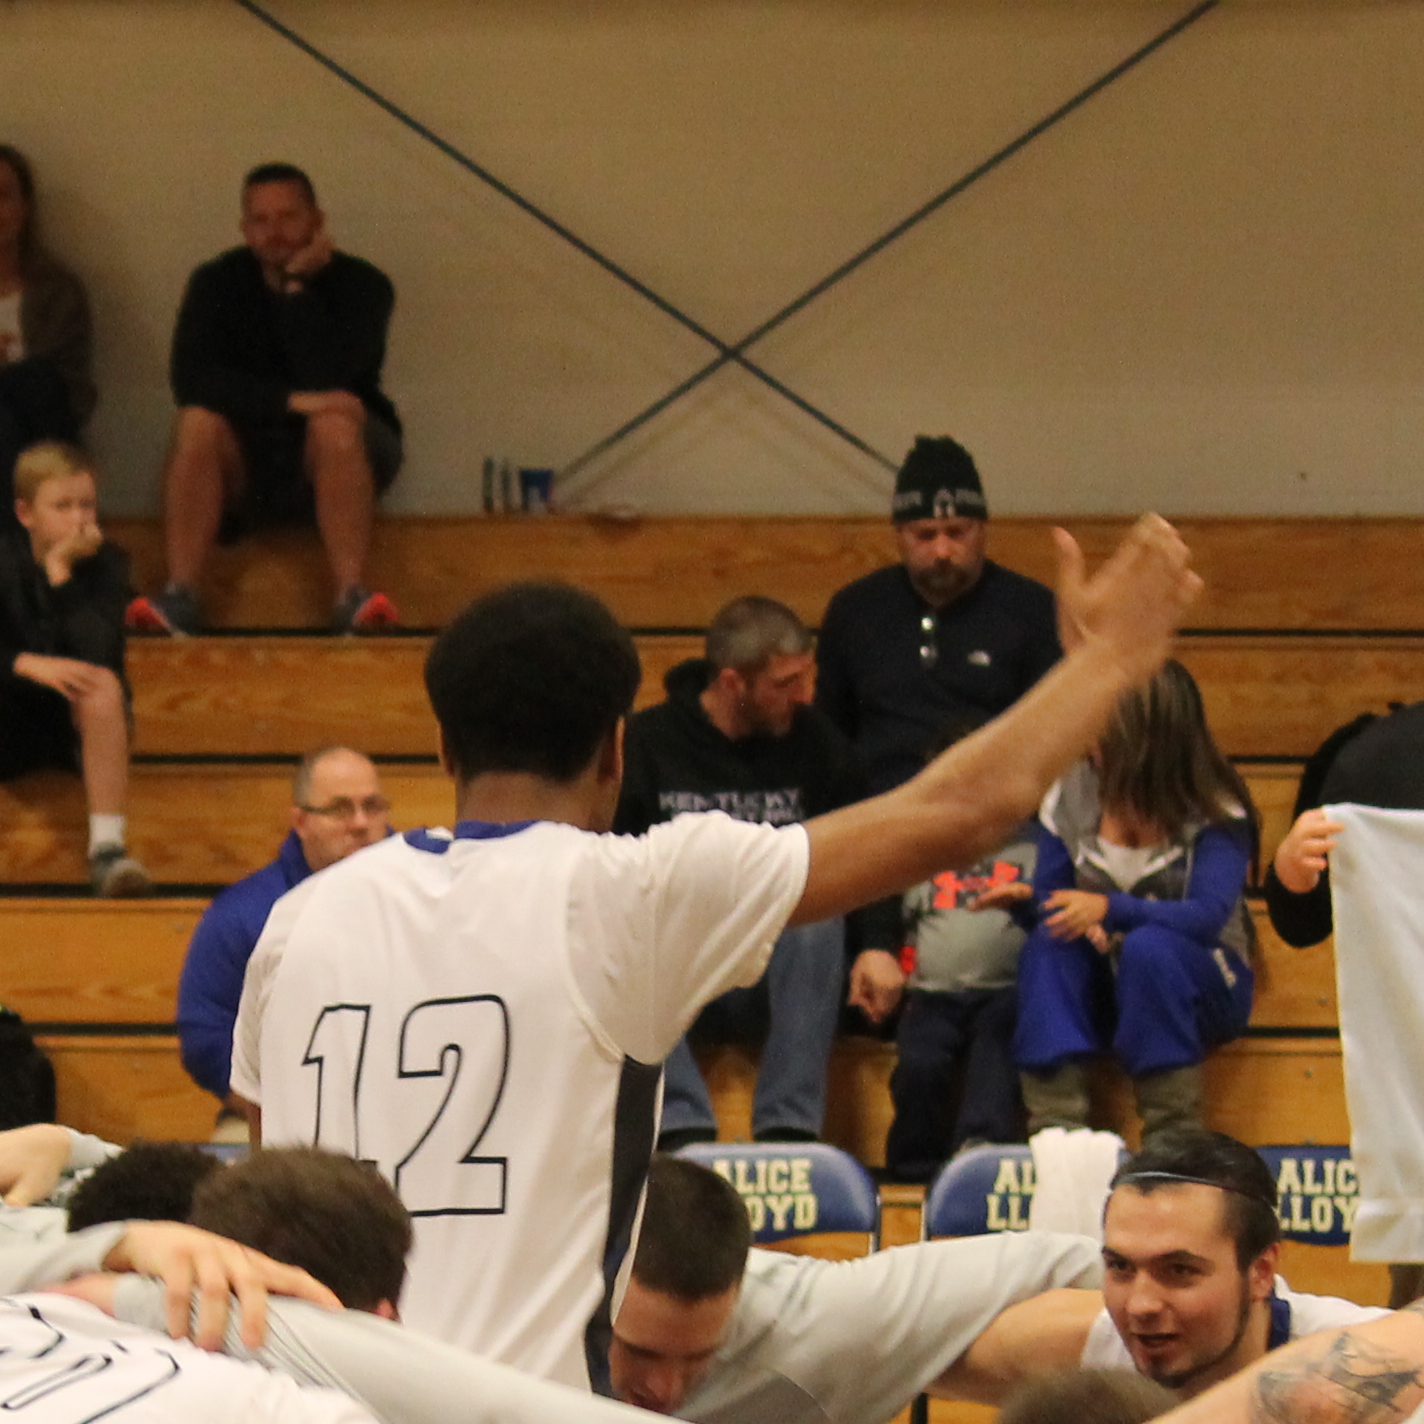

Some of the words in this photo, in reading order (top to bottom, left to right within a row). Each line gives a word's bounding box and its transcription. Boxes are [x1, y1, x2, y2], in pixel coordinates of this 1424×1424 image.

[302, 994, 510, 1217] 12
[1277, 1158, 1358, 1194] ALIC
[745, 1193, 818, 1231] OYD
[1272, 1195, 1360, 1232] LLOY
